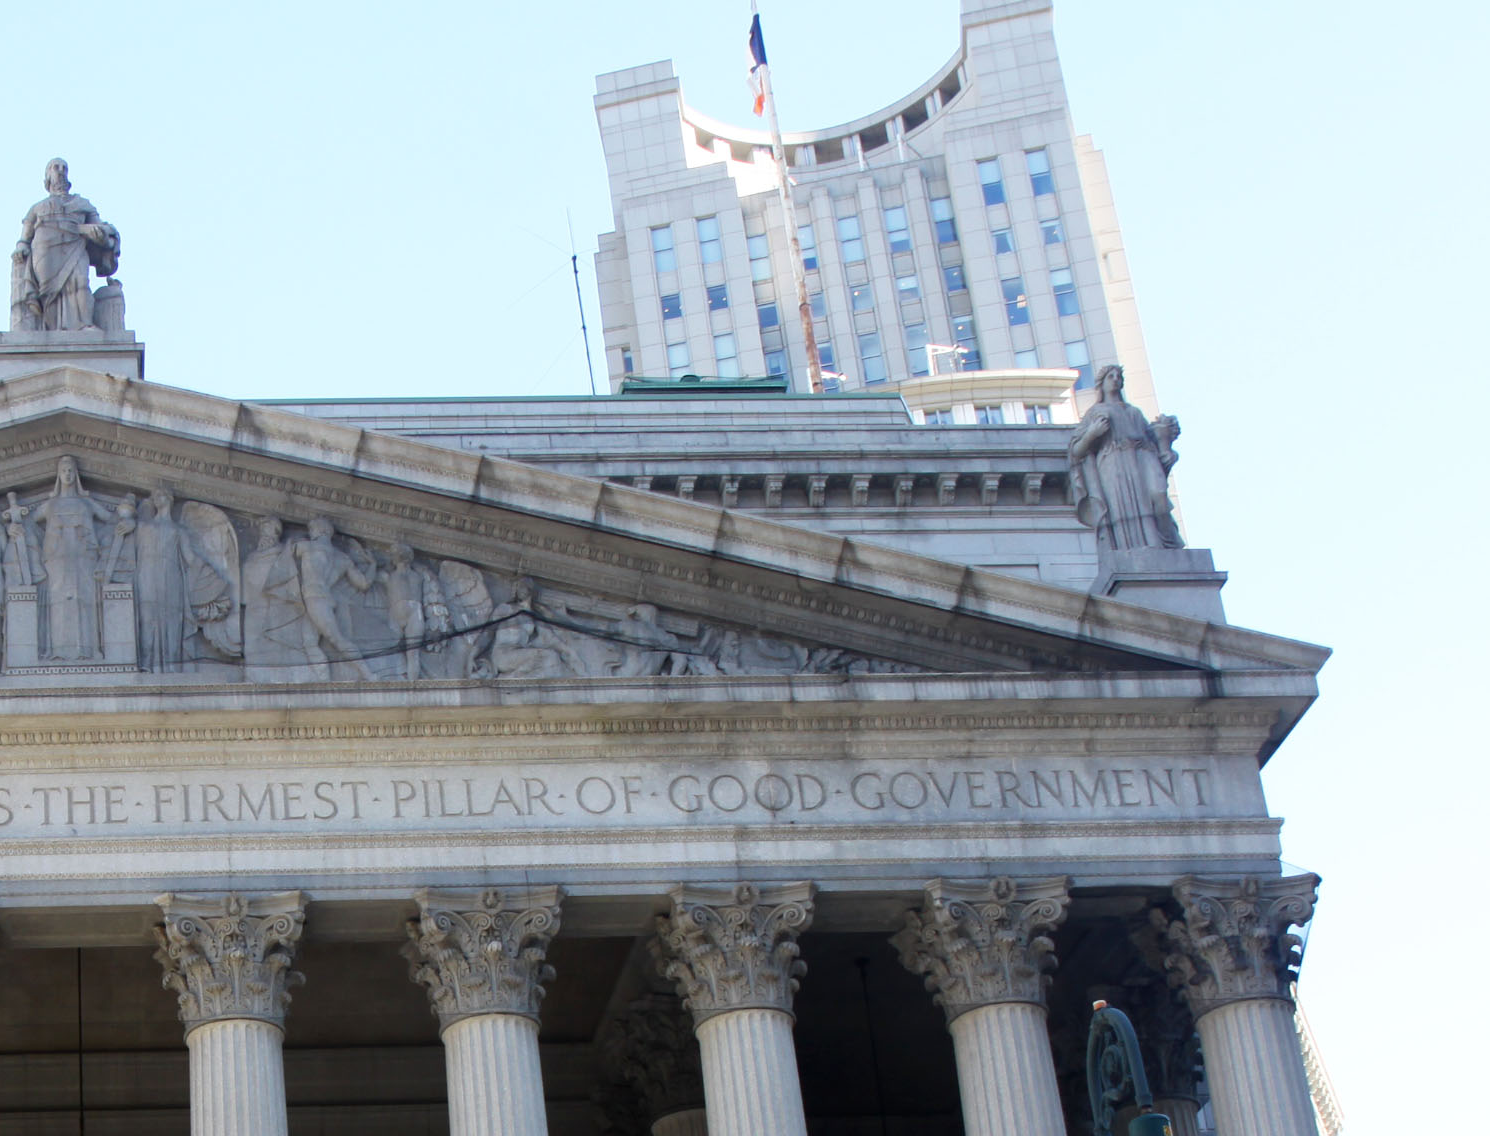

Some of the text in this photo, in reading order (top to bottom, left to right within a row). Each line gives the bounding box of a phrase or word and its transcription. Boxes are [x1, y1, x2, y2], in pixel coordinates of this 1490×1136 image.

[32, 785, 129, 827] THE
[151, 781, 371, 824] FIRMEST
[391, 777, 562, 818] PILLAR
[575, 774, 642, 815] OF
[668, 773, 827, 813] GOOD
[850, 768, 1209, 811] GOVERNMENT
